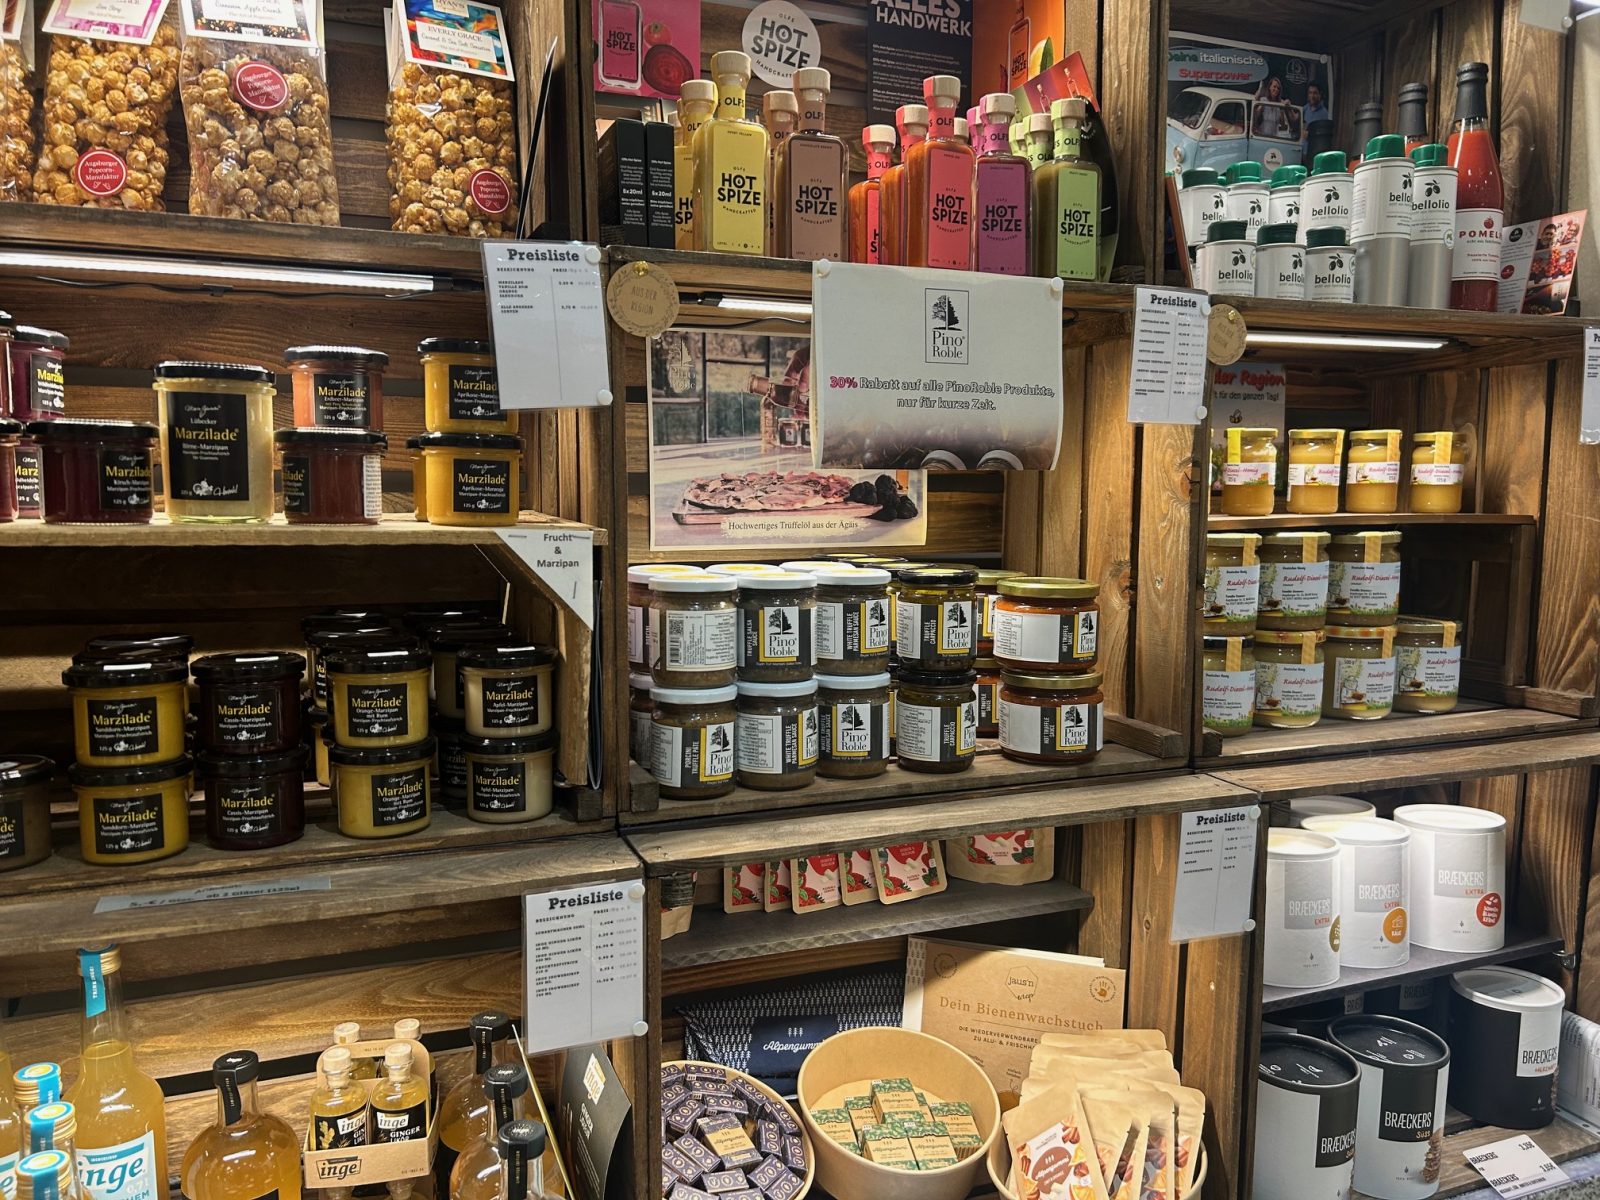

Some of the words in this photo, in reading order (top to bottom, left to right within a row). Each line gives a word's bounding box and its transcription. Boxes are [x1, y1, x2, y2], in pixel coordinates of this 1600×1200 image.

[875, 9, 972, 38] HANDWERK
[608, 30, 632, 41] HOT
[759, 17, 808, 49] HOT
[606, 38, 636, 52] SPIZE
[751, 35, 811, 71] SPIZE
[1199, 51, 1264, 66] italienische
[1178, 67, 1253, 80] Superpower
[84, 161, 118, 169] Augsburger
[88, 167, 115, 175] Popcorn-
[85, 173, 119, 181] Manufaktur
[721, 173, 757, 189] HOT
[717, 188, 761, 207] SPIZE
[799, 185, 833, 201] HOT
[795, 199, 838, 216] SPIZE
[935, 193, 965, 210] HOT
[1411, 199, 1450, 211] bellolio
[932, 207, 968, 226] SPIZE
[985, 205, 1018, 219] HOT
[1063, 208, 1091, 223] HOT
[1311, 206, 1349, 218] bellolio
[982, 217, 1022, 232] SPIZE
[1060, 220, 1093, 237] SPIZE
[507, 248, 579, 263] Preisliste
[1218, 269, 1254, 281] bellolio
[1314, 273, 1352, 285] bellolio
[1150, 293, 1197, 308] Preisliste
[630, 303, 654, 315] REGION
[931, 330, 963, 348] Pino
[932, 344, 963, 359] Roble
[830, 375, 858, 391] 30%
[859, 376, 900, 392] Rabatt
[900, 378, 922, 392] auf
[923, 379, 943, 392] alle
[945, 380, 1002, 396] PinoRoble
[1004, 384, 1056, 398] Produkte,
[1240, 370, 1284, 391] Region
[318, 386, 365, 398] Marzilade
[1219, 390, 1229, 399] für
[1229, 391, 1242, 400] den
[1242, 392, 1265, 402] ganzen
[1266, 391, 1280, 402] Tag!
[896, 400, 917, 409] nur
[918, 396, 936, 409] für
[937, 397, 968, 410] kurze
[970, 399, 998, 411] Zeit.
[175, 427, 238, 442] Marzilade
[457, 472, 505, 485] Marzilade
[728, 520, 779, 531] Hochwertiges
[779, 520, 812, 531] Trüffelöl
[812, 522, 825, 530] aus
[826, 521, 837, 530] der
[543, 533, 574, 542] Frucht
[554, 546, 562, 555] &
[537, 559, 580, 568] Marzipan
[870, 628, 889, 640] Pino
[947, 628, 969, 640] Pino
[768, 634, 797, 648] Pino
[870, 638, 889, 647] Roble
[947, 639, 969, 649] Roble
[768, 646, 797, 656] Roble
[486, 690, 534, 701] Marzilade
[351, 697, 403, 708] Marzilade
[218, 704, 272, 716] Marzilade
[92, 711, 152, 726] Marzilade
[840, 731, 868, 743] Pino
[1064, 727, 1086, 739] Pino
[841, 740, 868, 751] Roble
[1065, 736, 1087, 747] Roble
[691, 754, 699, 775] TRUFFLE
[709, 753, 732, 767] Pino
[709, 763, 732, 775] Roble
[475, 774, 521, 786] Marzilade
[376, 783, 424, 797] Marzilade
[221, 796, 274, 808] Marzilade
[98, 809, 158, 824] Marzilade
[1196, 812, 1246, 826] Preisliste
[1465, 888, 1485, 896] EXTRA
[548, 890, 624, 910] Preisliste
[1314, 916, 1331, 926] EXTRA
[939, 995, 971, 1012] Dein
[976, 1002, 1104, 1031] Bienenwachstuch
[958, 1024, 969, 1032] DIE
[969, 1027, 1040, 1044] WIEDERVERWENDBARE
[973, 1034, 982, 1042] ZU
[378, 1112, 407, 1131] inge
[389, 1125, 421, 1138] GINGER
[320, 1161, 358, 1180] inge
